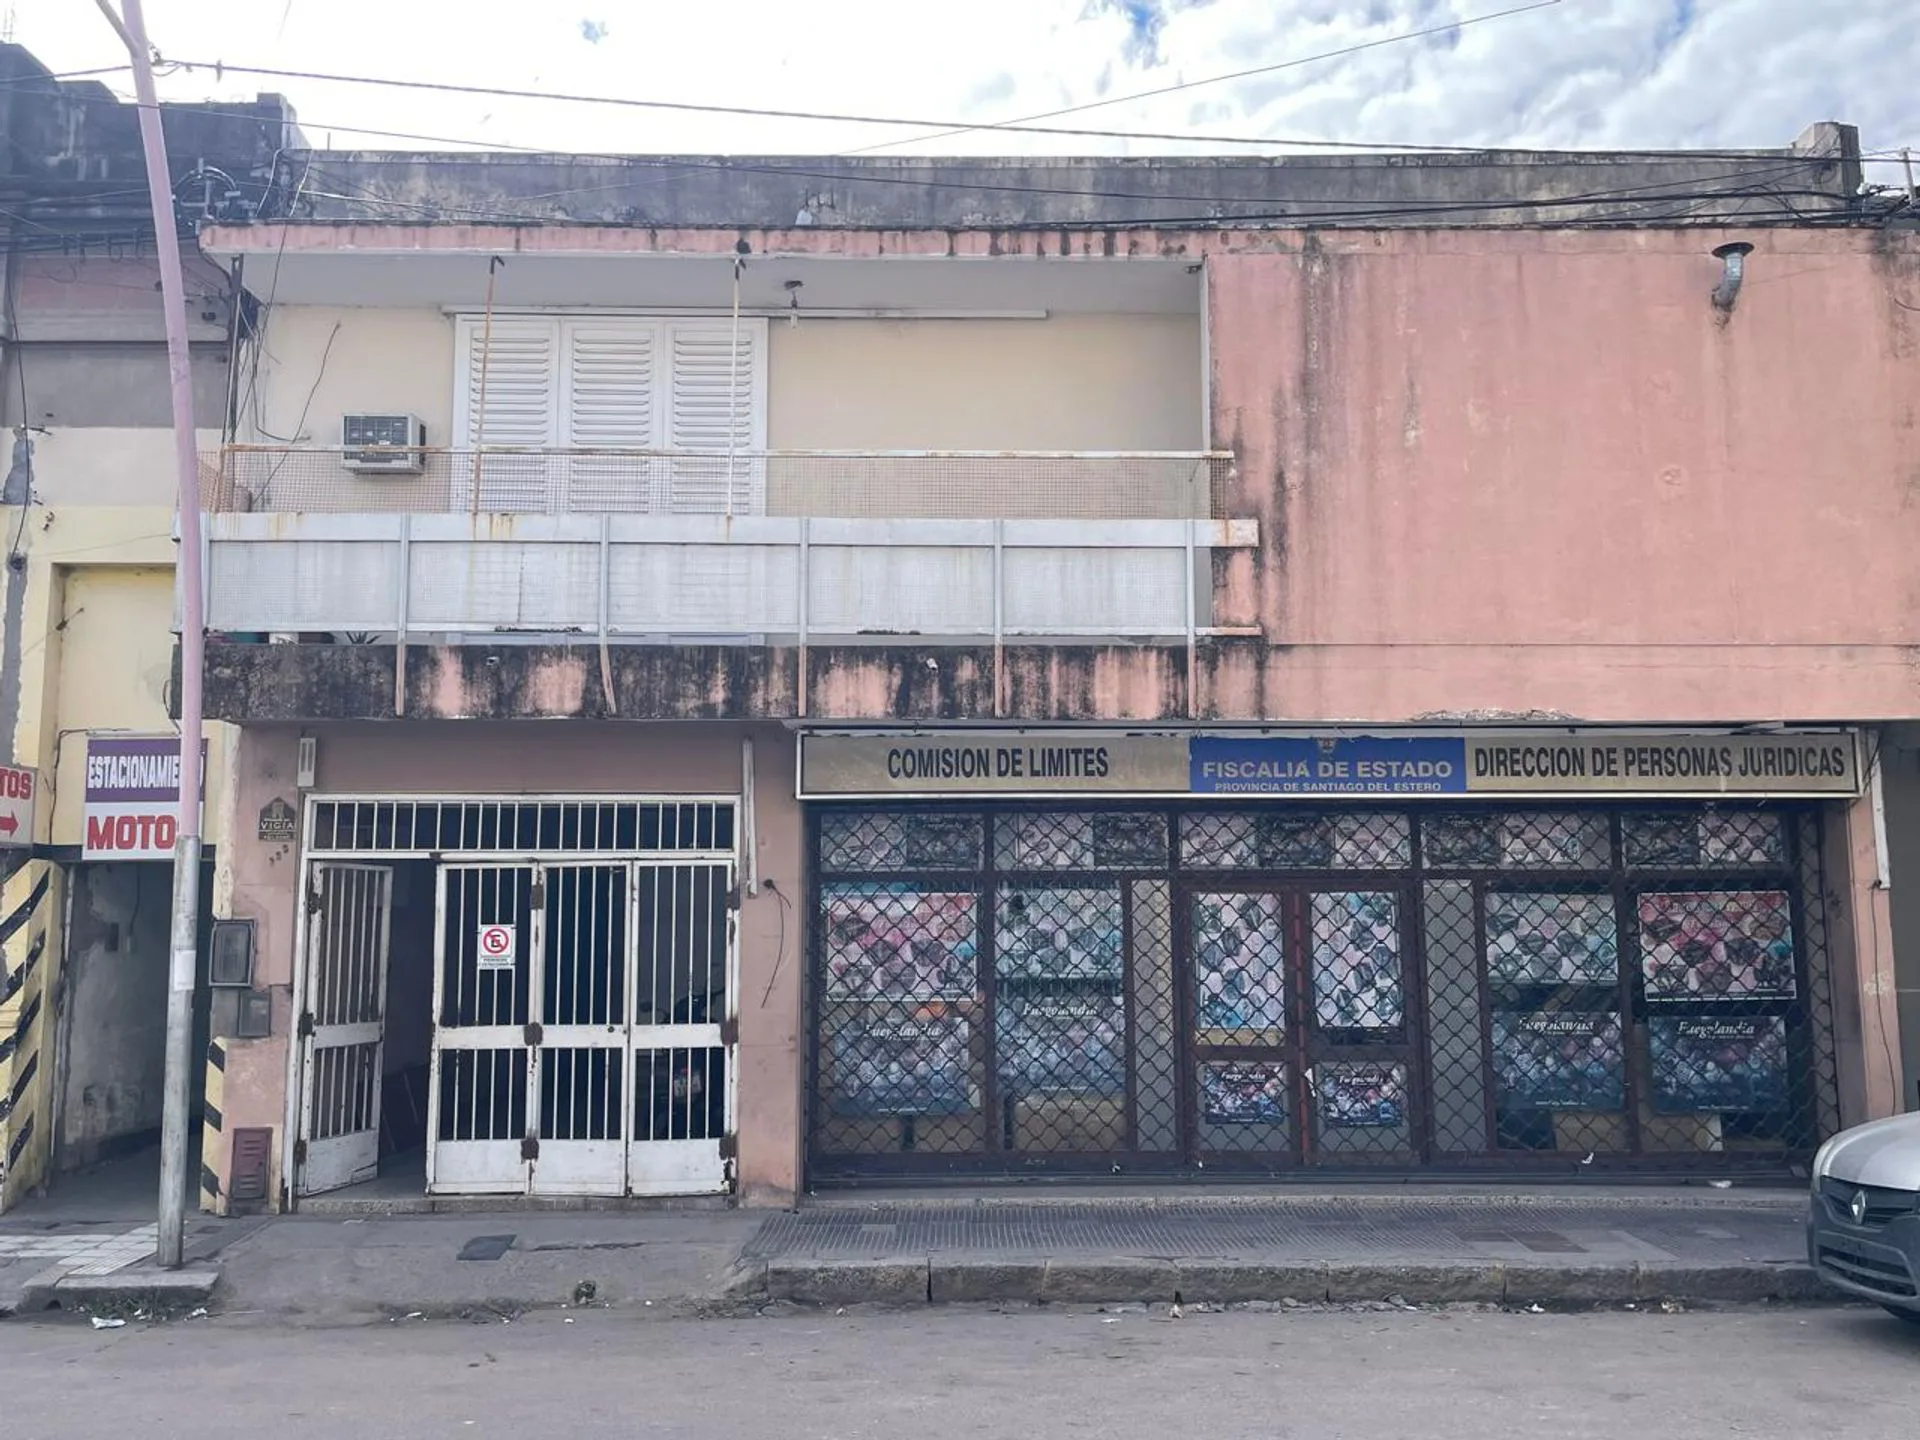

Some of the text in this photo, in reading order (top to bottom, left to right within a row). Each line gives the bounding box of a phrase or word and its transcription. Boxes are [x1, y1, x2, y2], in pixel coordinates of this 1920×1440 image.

[888, 748, 1109, 778] COMISION DE LIMITES
[1317, 761, 1350, 778] DE
[1357, 761, 1452, 778] ESTADO
[1475, 747, 1845, 777] DIRECCION DE PERSONAS JURIDICAS
[1215, 782, 1441, 791] PROVINCIA DE SANTIAGO DEL ESTERO
[87, 814, 181, 850] MOTO
